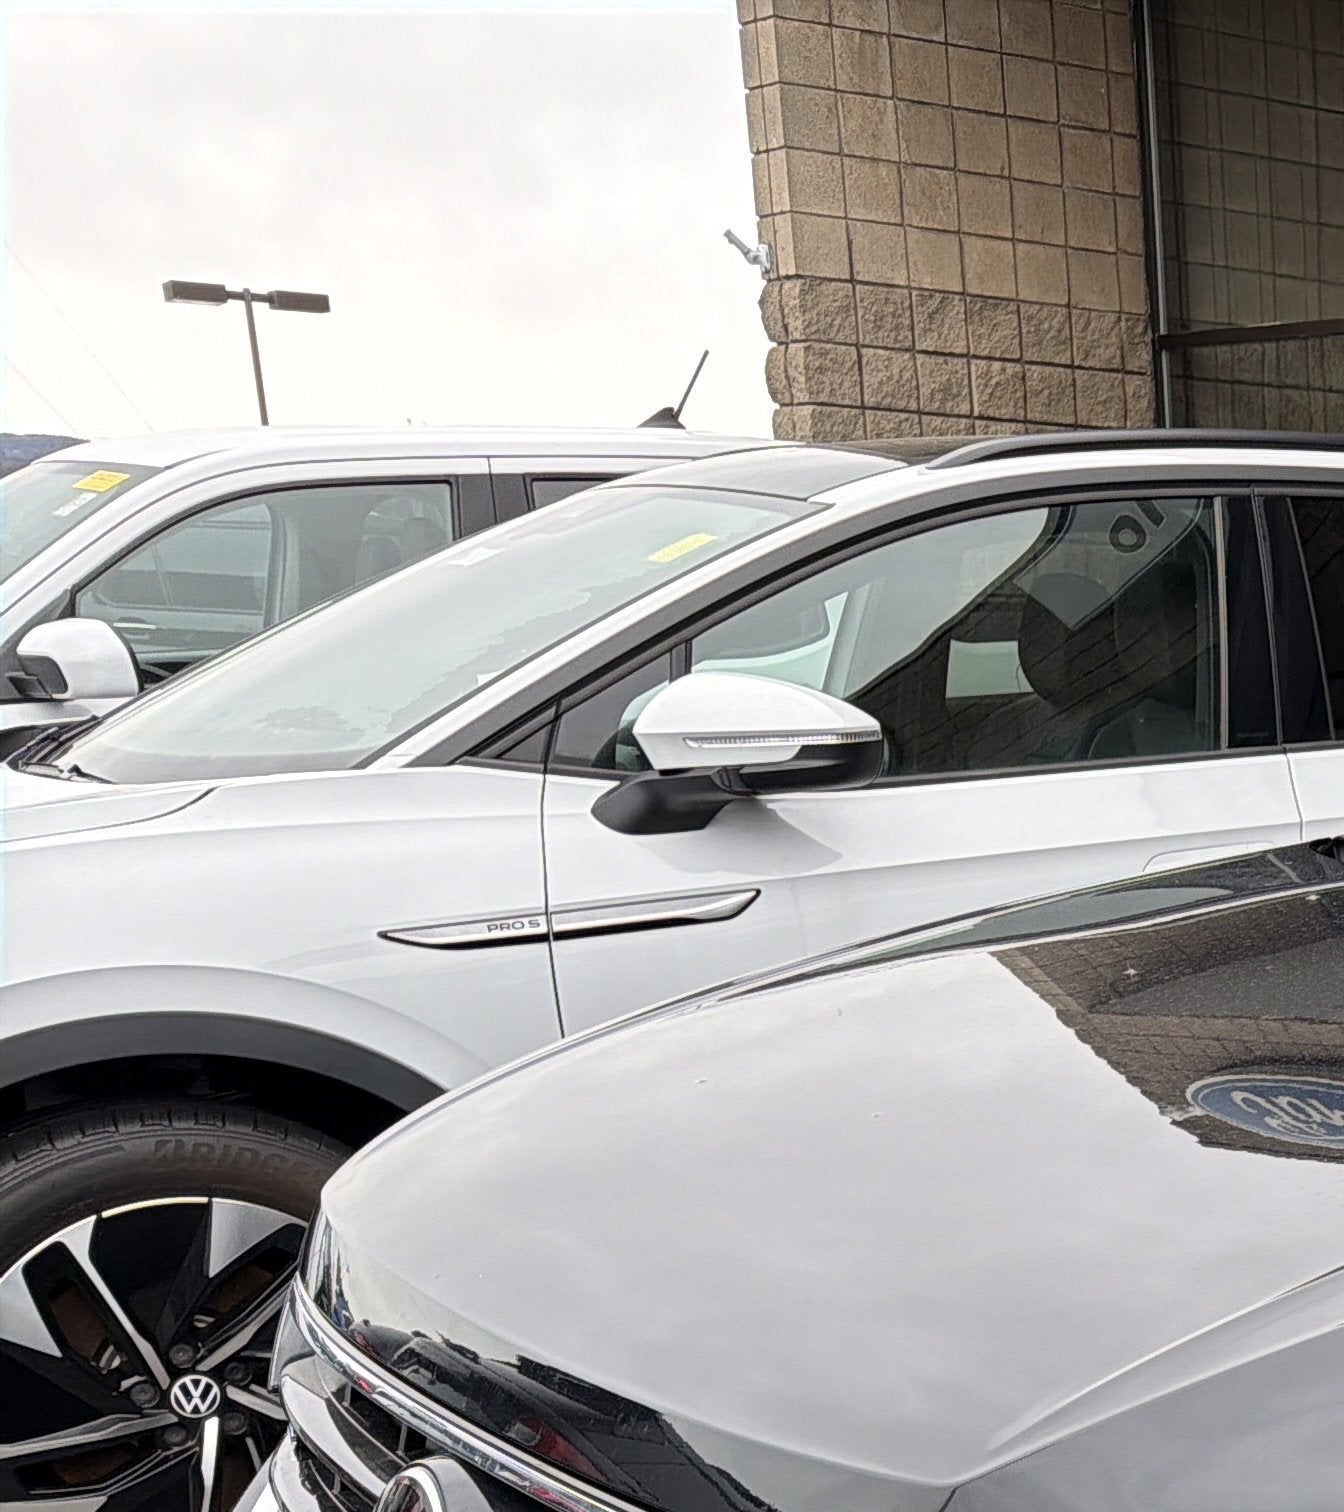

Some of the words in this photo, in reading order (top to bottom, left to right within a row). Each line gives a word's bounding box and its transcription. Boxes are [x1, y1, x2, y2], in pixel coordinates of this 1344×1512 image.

[486, 920, 525, 933] PRO
[528, 918, 541, 929] S
[170, 1374, 221, 1418] VW
